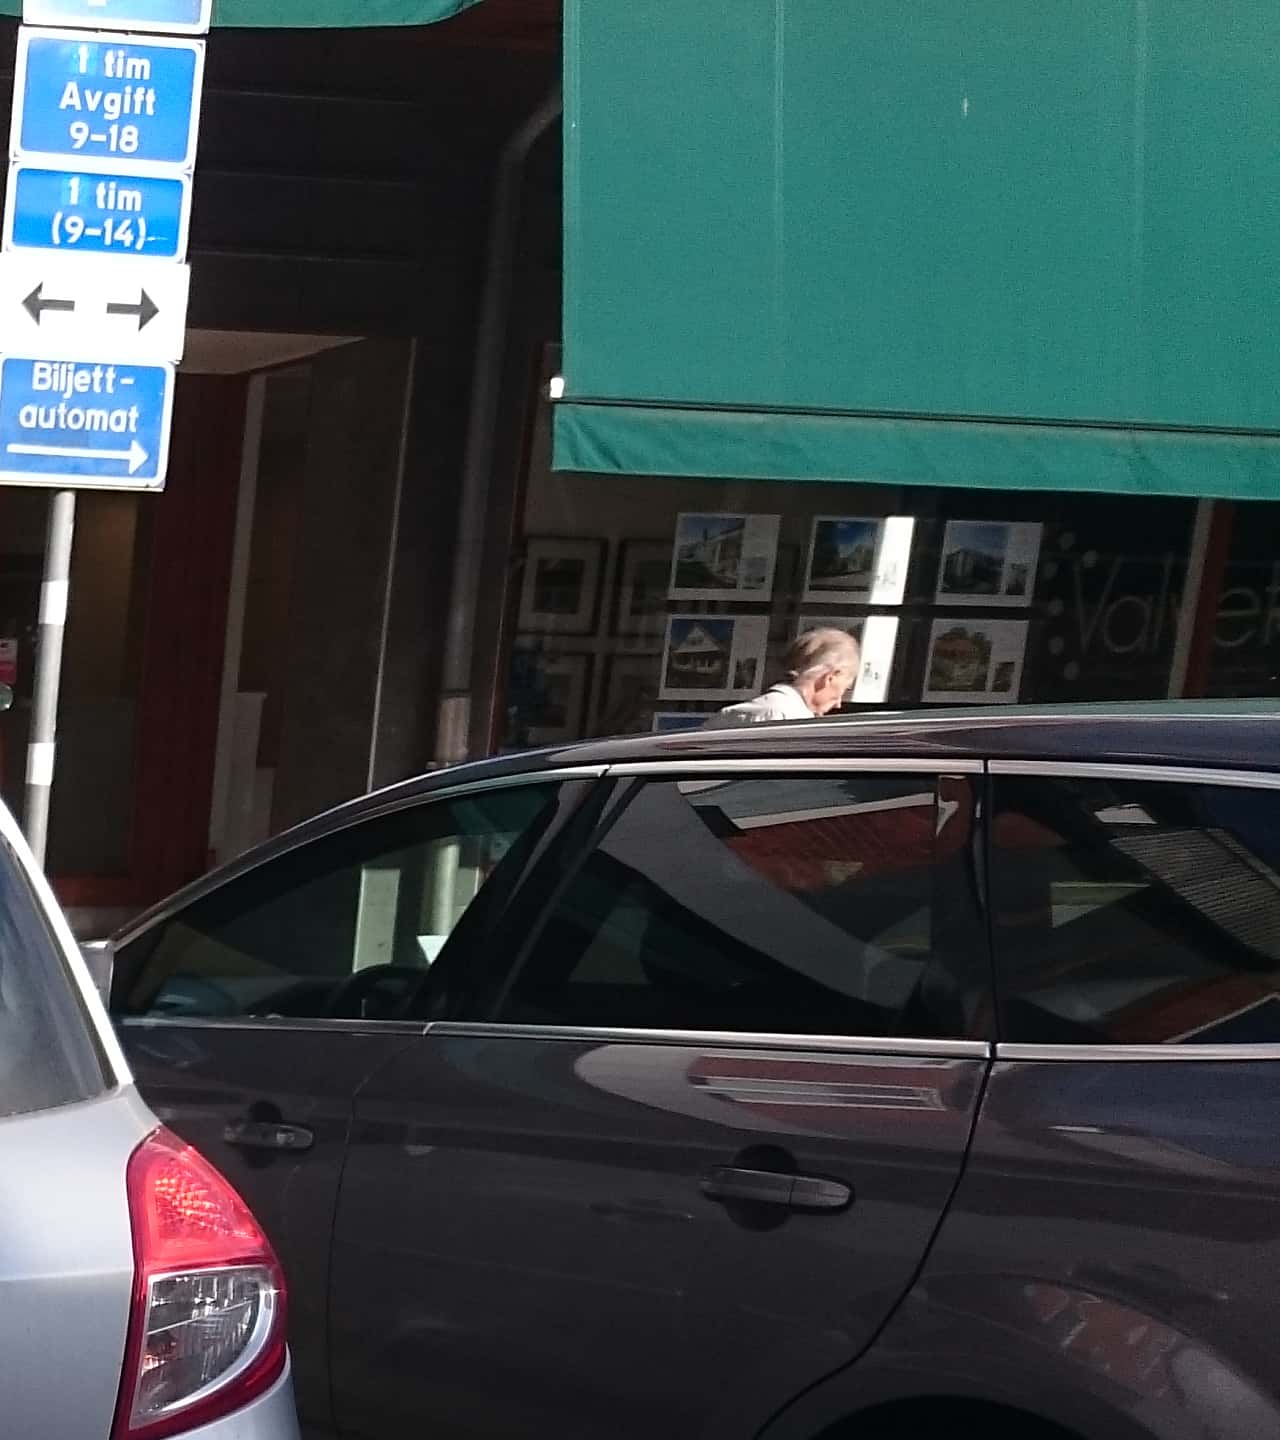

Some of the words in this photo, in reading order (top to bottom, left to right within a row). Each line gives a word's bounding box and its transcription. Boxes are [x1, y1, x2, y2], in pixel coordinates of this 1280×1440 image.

[77, 44, 89, 74] 1
[103, 49, 151, 81] tim
[58, 81, 156, 121] Avgift
[69, 122, 139, 153] 9-18
[67, 177, 80, 206] 1
[95, 182, 142, 212] tim
[51, 211, 146, 250] (9-14)
[32, 361, 135, 400] Biljett-
[18, 402, 139, 434] automat
